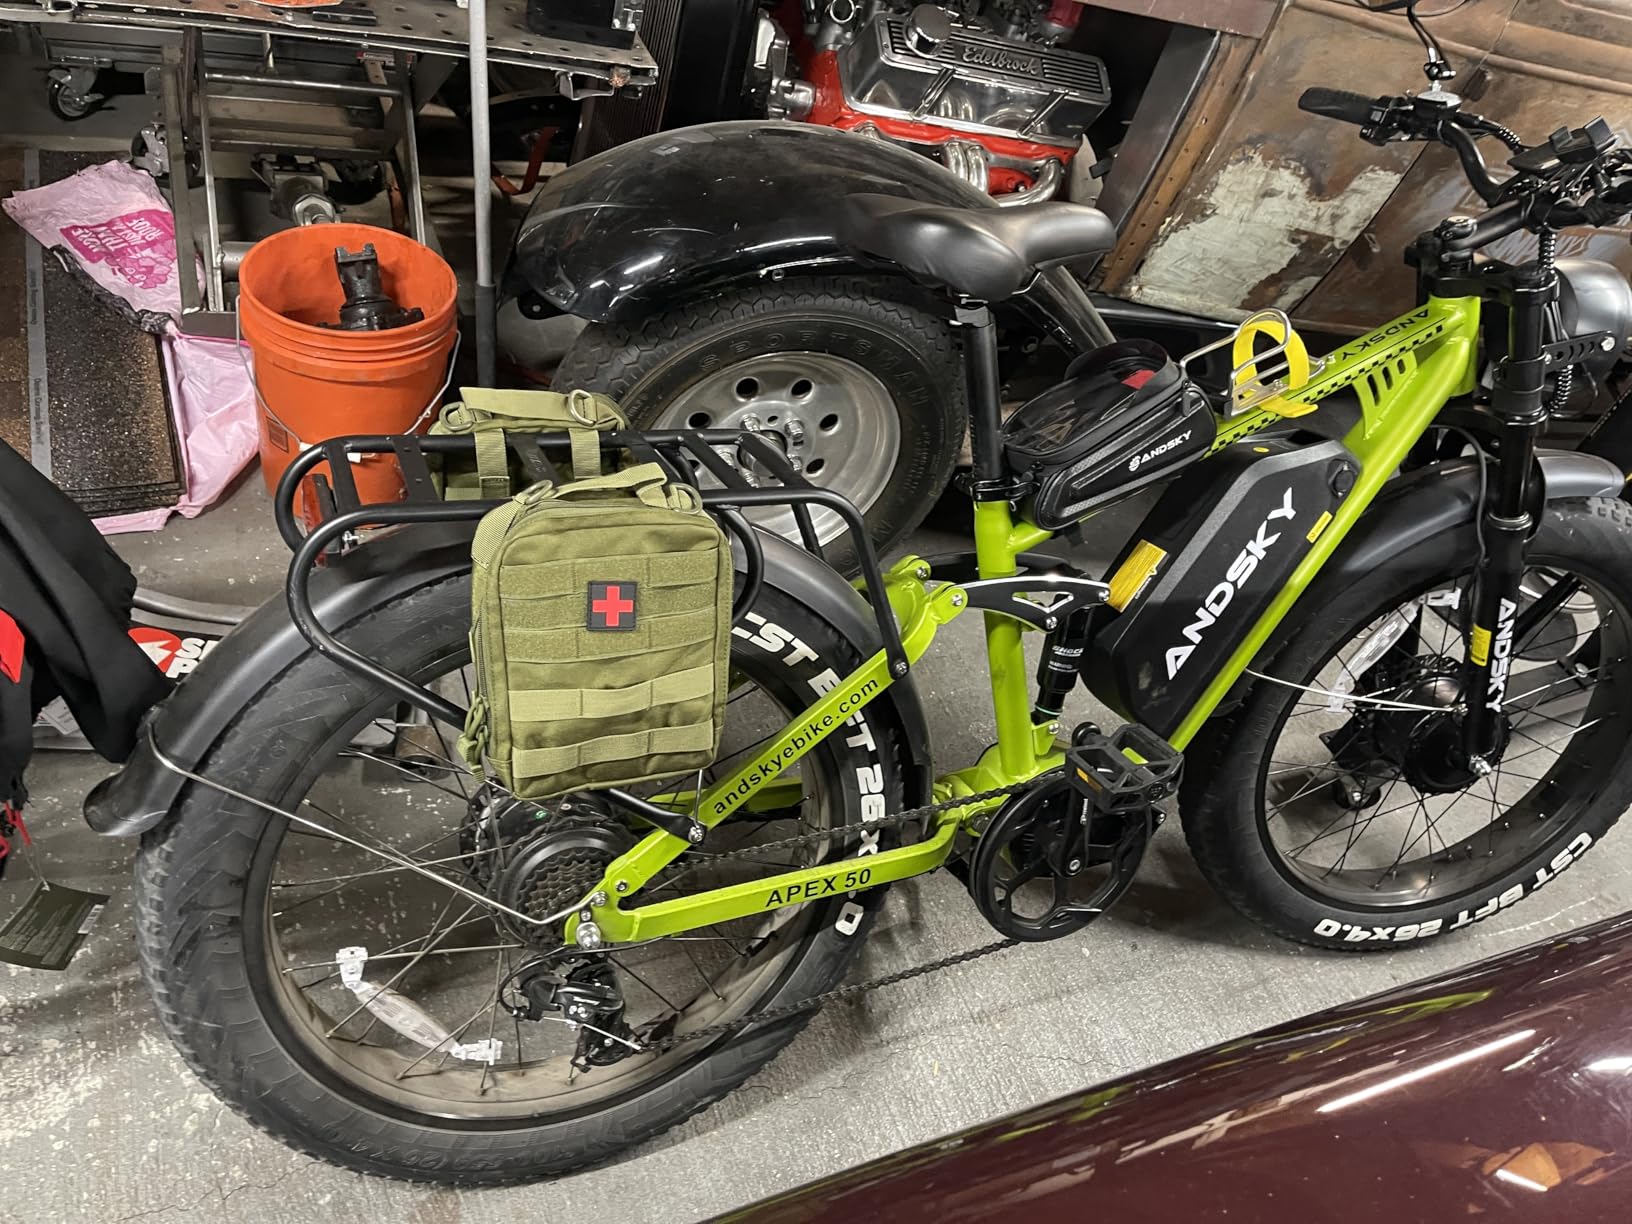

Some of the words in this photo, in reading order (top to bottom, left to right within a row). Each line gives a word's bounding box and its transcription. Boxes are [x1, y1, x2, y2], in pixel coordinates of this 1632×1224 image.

[962, 45, 1038, 75] Edelbrock
[1341, 308, 1430, 361] ANDSKY
[1140, 429, 1193, 464] ANDSKY
[1165, 486, 1297, 681] ANDSKY
[1485, 597, 1518, 713] ANDSKY
[713, 678, 880, 815] andskyebike.com
[765, 877, 837, 908] APEX
[844, 867, 872, 889] 50
[1533, 832, 1593, 890] CST
[1449, 883, 1524, 930] BFT
